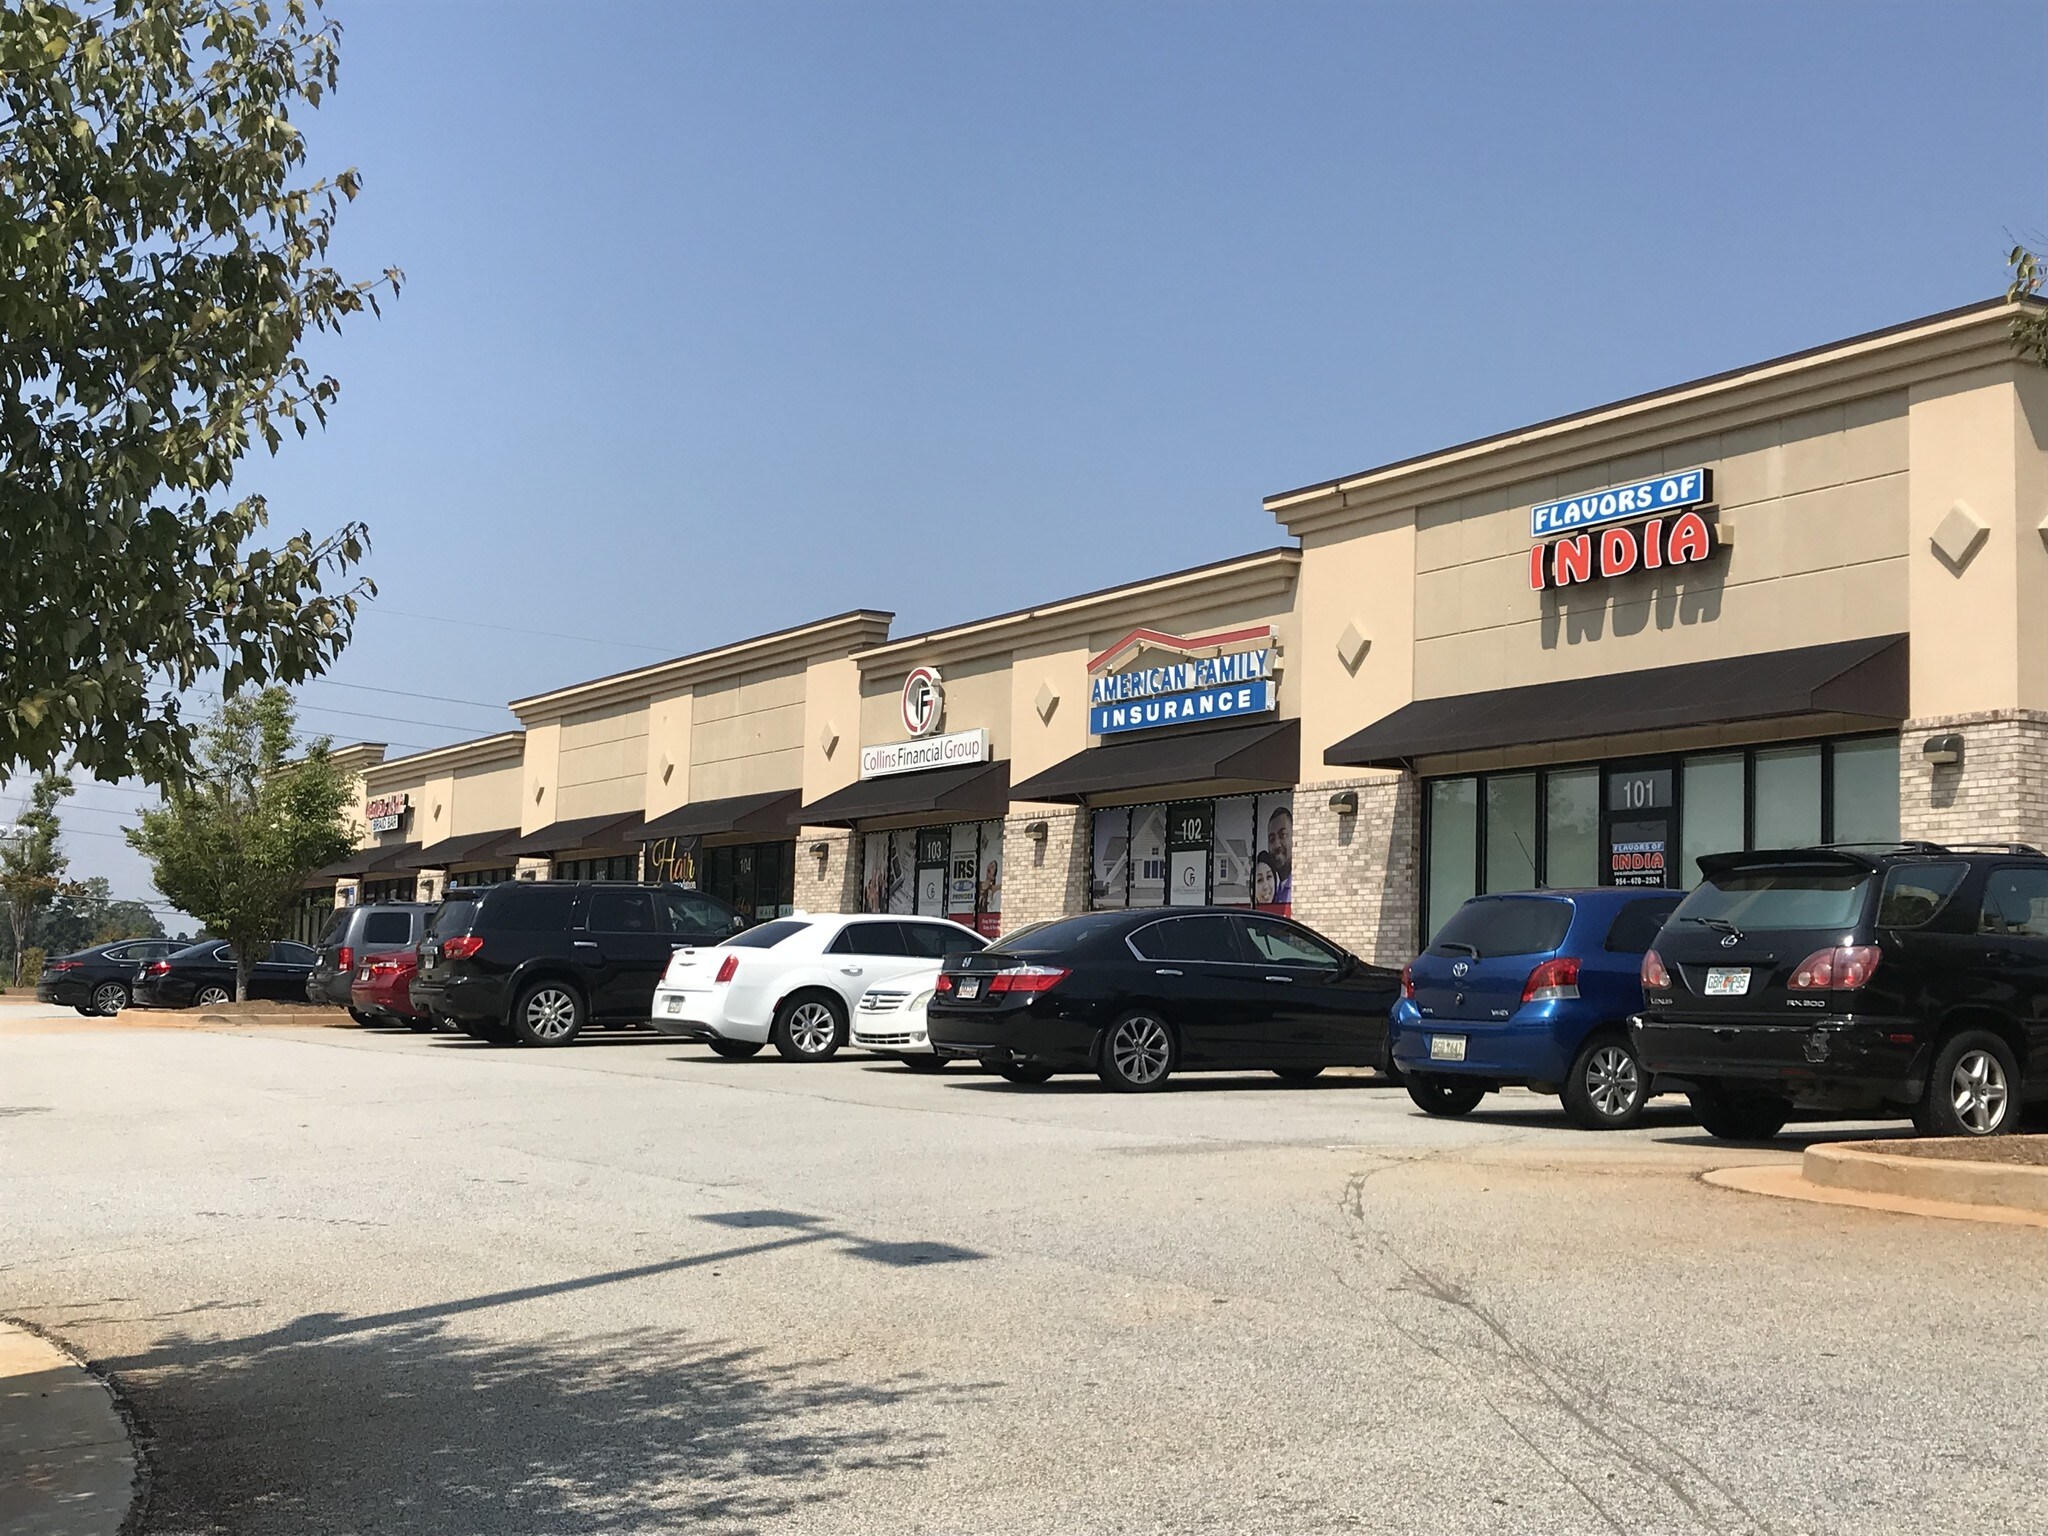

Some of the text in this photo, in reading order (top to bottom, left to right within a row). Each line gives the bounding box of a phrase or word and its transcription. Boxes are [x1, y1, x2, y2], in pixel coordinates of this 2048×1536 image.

[1535, 475, 1696, 530] FLAVORS OF
[1529, 512, 1709, 591] INDIA
[1091, 649, 1269, 702] AMERICAN FAMILY
[1102, 689, 1251, 729] INSURANCE
[863, 740, 979, 771] Collins Financial Group
[1624, 779, 1653, 807] 101
[1181, 818, 1202, 841] 102
[652, 837, 696, 882] Hair
[927, 841, 942, 860] 103
[1612, 852, 1664, 870] INDIA
[953, 860, 975, 880] IRS
